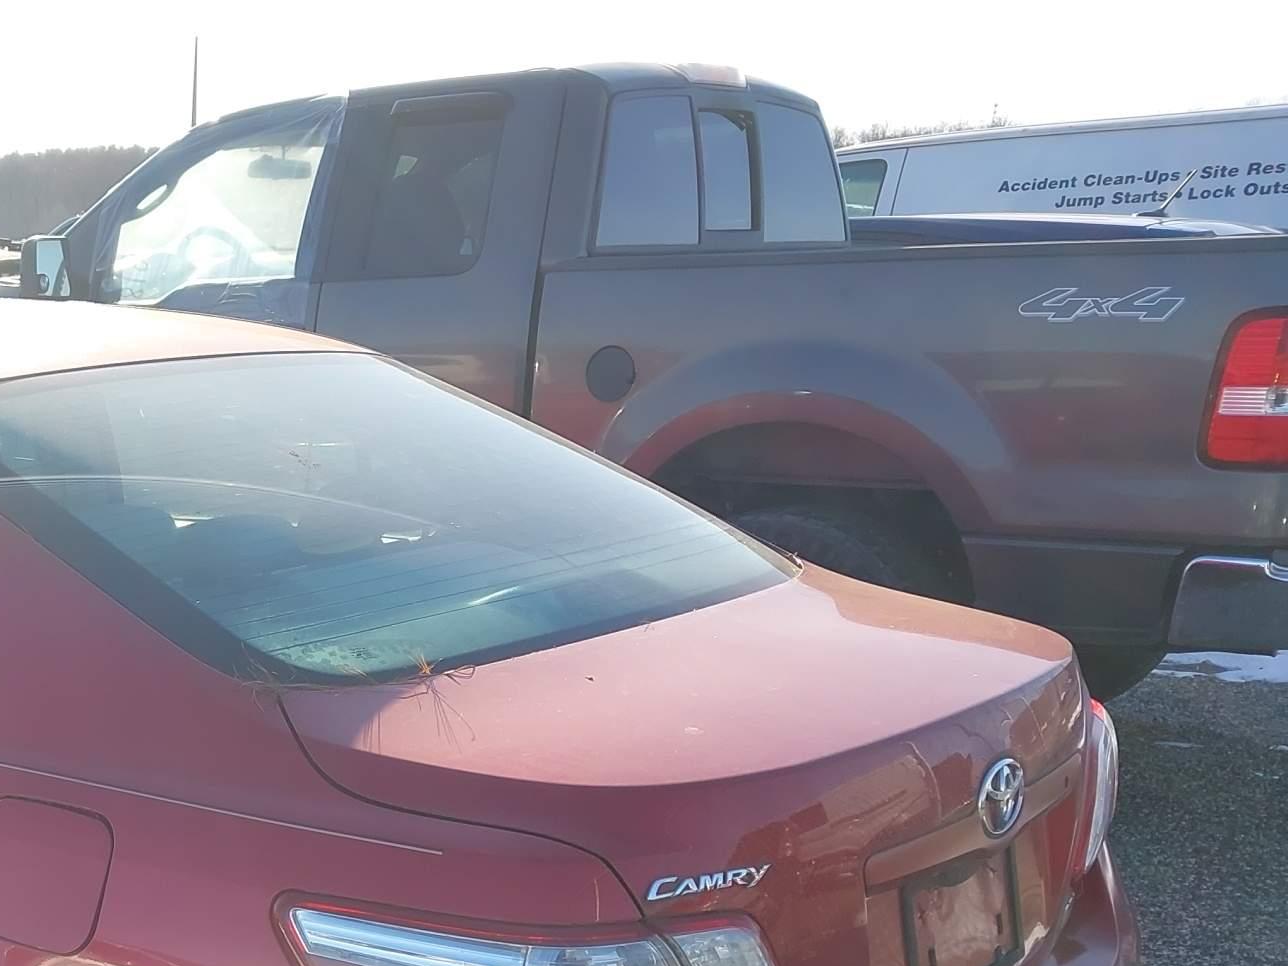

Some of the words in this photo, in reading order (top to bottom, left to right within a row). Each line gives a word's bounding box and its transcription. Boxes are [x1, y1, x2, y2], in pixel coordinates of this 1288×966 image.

[998, 176, 1077, 192] Accident
[1083, 170, 1180, 187] Clean-Ups
[1200, 165, 1239, 179] Site
[1055, 195, 1104, 208] Jump
[1112, 190, 1168, 204] Starts
[1188, 185, 1235, 200] Lock
[1018, 286, 1185, 322] 4x4
[646, 863, 772, 900] CAMRY
